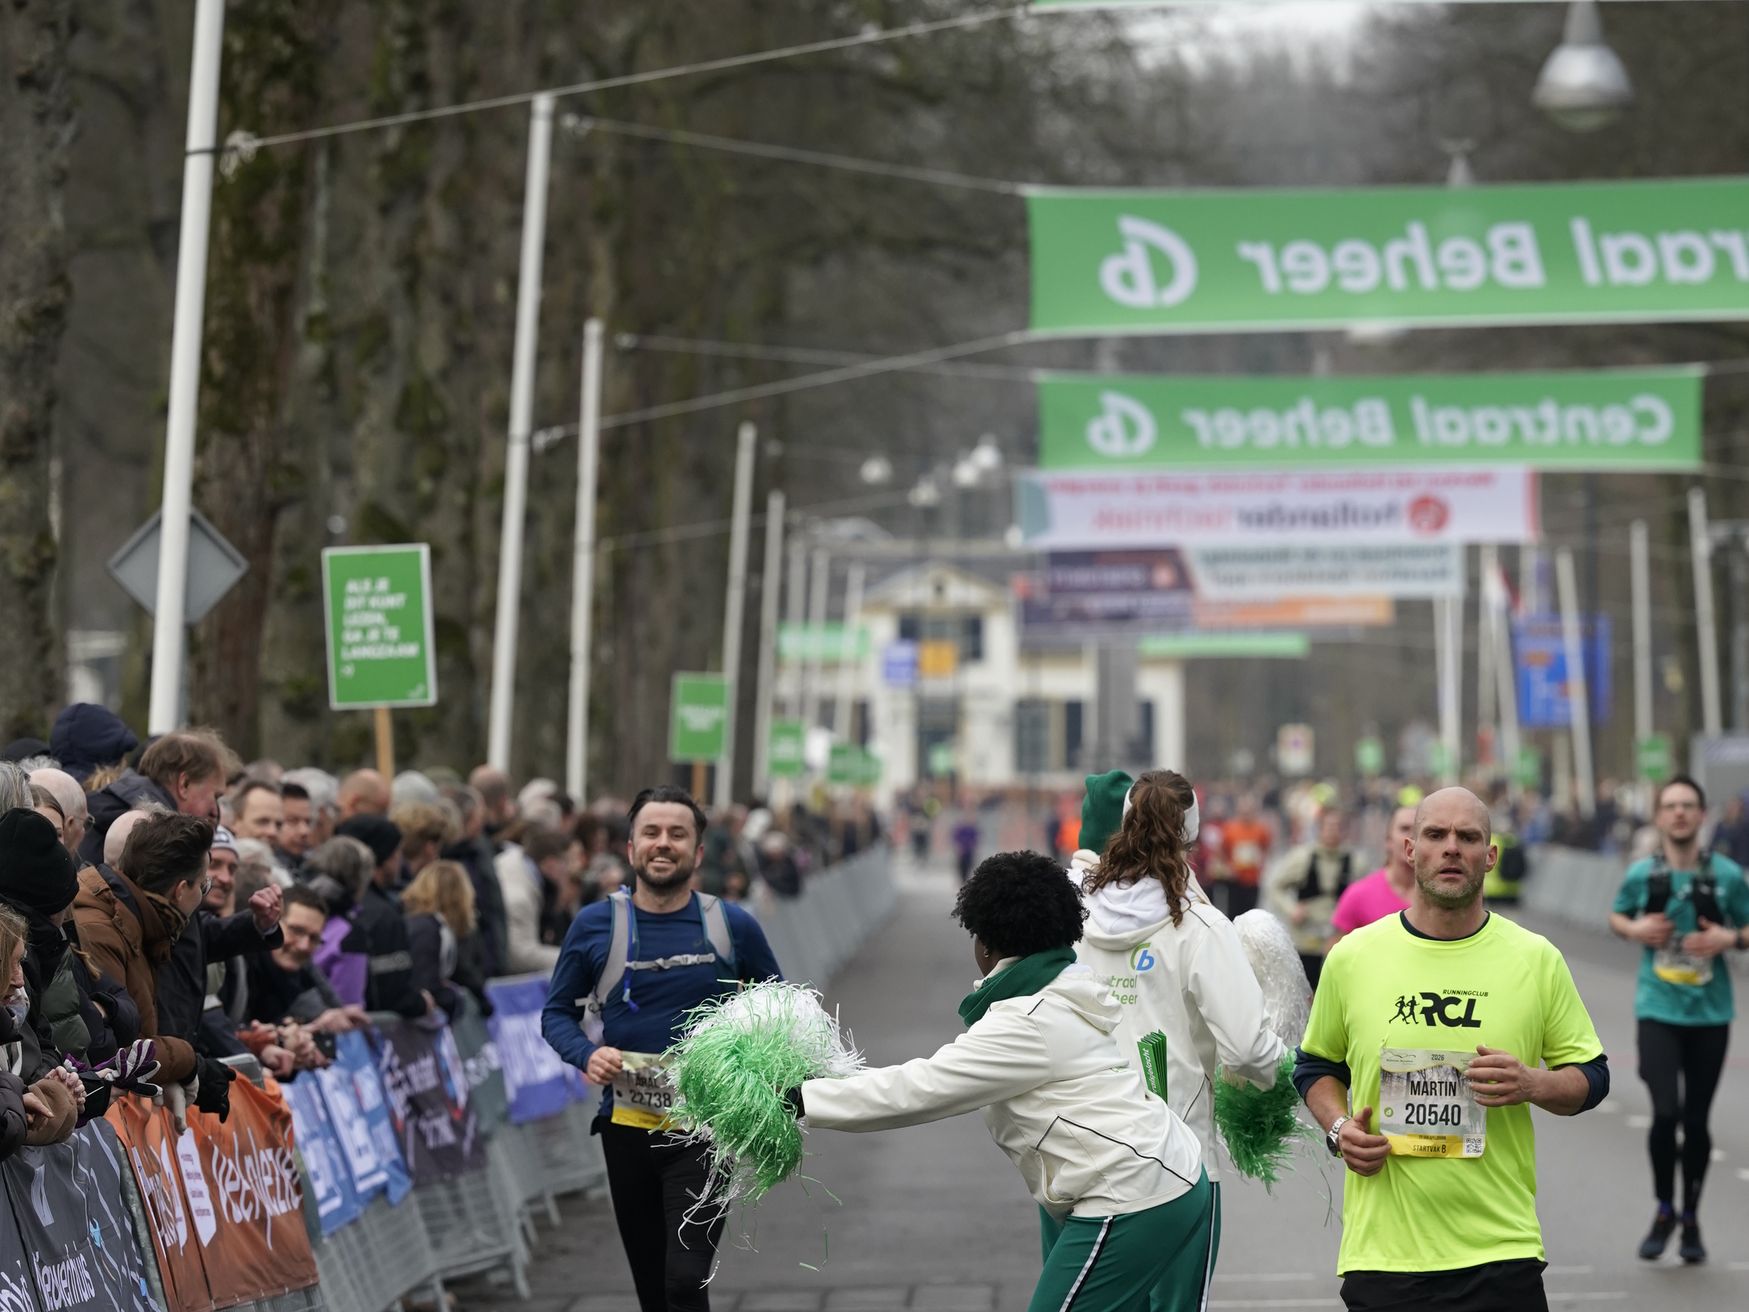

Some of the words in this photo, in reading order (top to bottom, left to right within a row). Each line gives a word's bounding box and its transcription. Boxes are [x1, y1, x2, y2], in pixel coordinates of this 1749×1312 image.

[1442, 989, 1489, 998] RUNNINGCLUB
[1419, 991, 1482, 1028] RCL
[1431, 1053, 1445, 1061] 2026
[1410, 1080, 1457, 1097] MARTIN
[629, 1089, 672, 1109] 22738
[1404, 1103, 1462, 1126] 20540
[1412, 1144, 1441, 1153] STARTVAK
[1441, 1144, 1447, 1154] B
